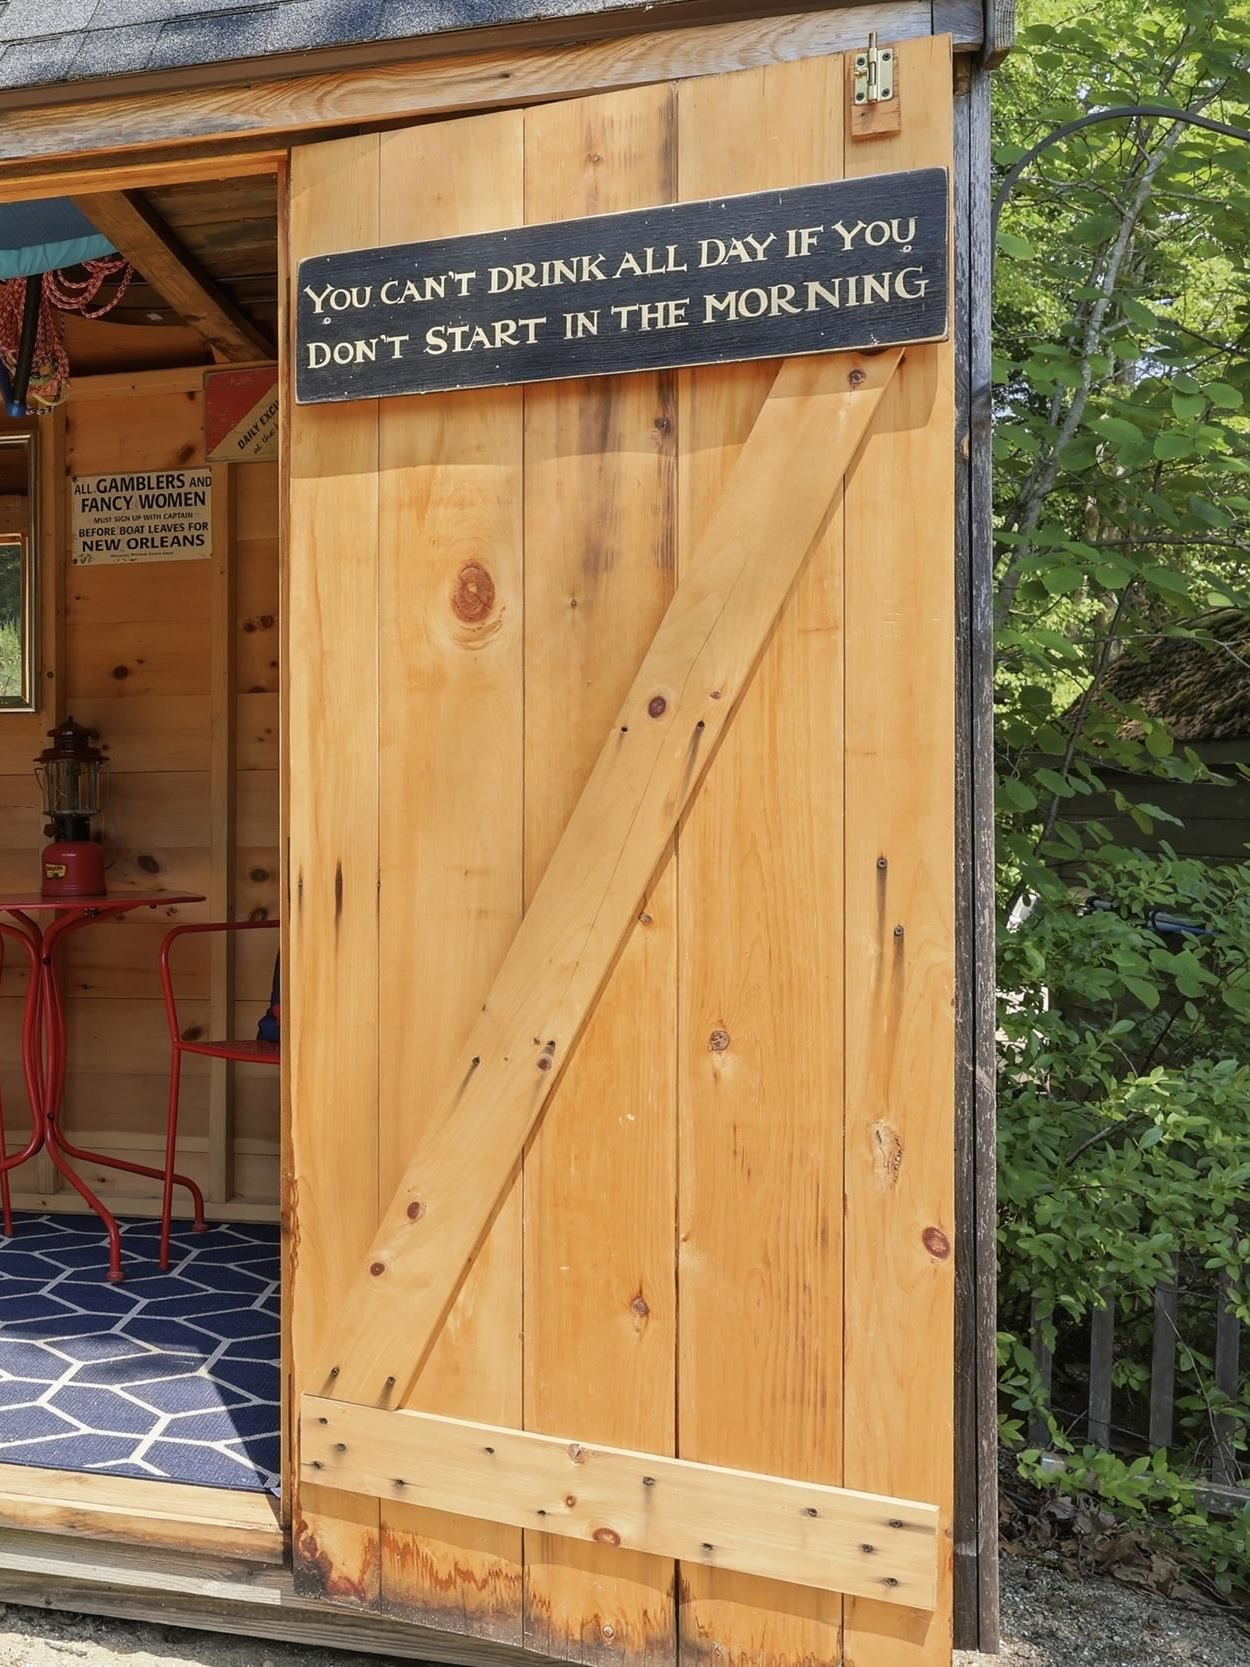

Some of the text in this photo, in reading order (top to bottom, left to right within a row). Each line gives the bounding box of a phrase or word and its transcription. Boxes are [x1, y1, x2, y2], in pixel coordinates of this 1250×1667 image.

[304, 217, 917, 314] YOU CAN'T DRINK ALL DAY IF YOU
[307, 266, 928, 369] DON'T START IN THE MORNING
[237, 424, 261, 451] DAILY
[74, 473, 212, 496] ALL GAMBLERS AND
[81, 491, 206, 513] FANCY WOMEN
[93, 511, 193, 524] MUST SIGN UP WITH CAPTAIN
[79, 521, 209, 538] BEFORE BOAT LEAVES FOR
[82, 533, 205, 552] NEW ORLEANS
